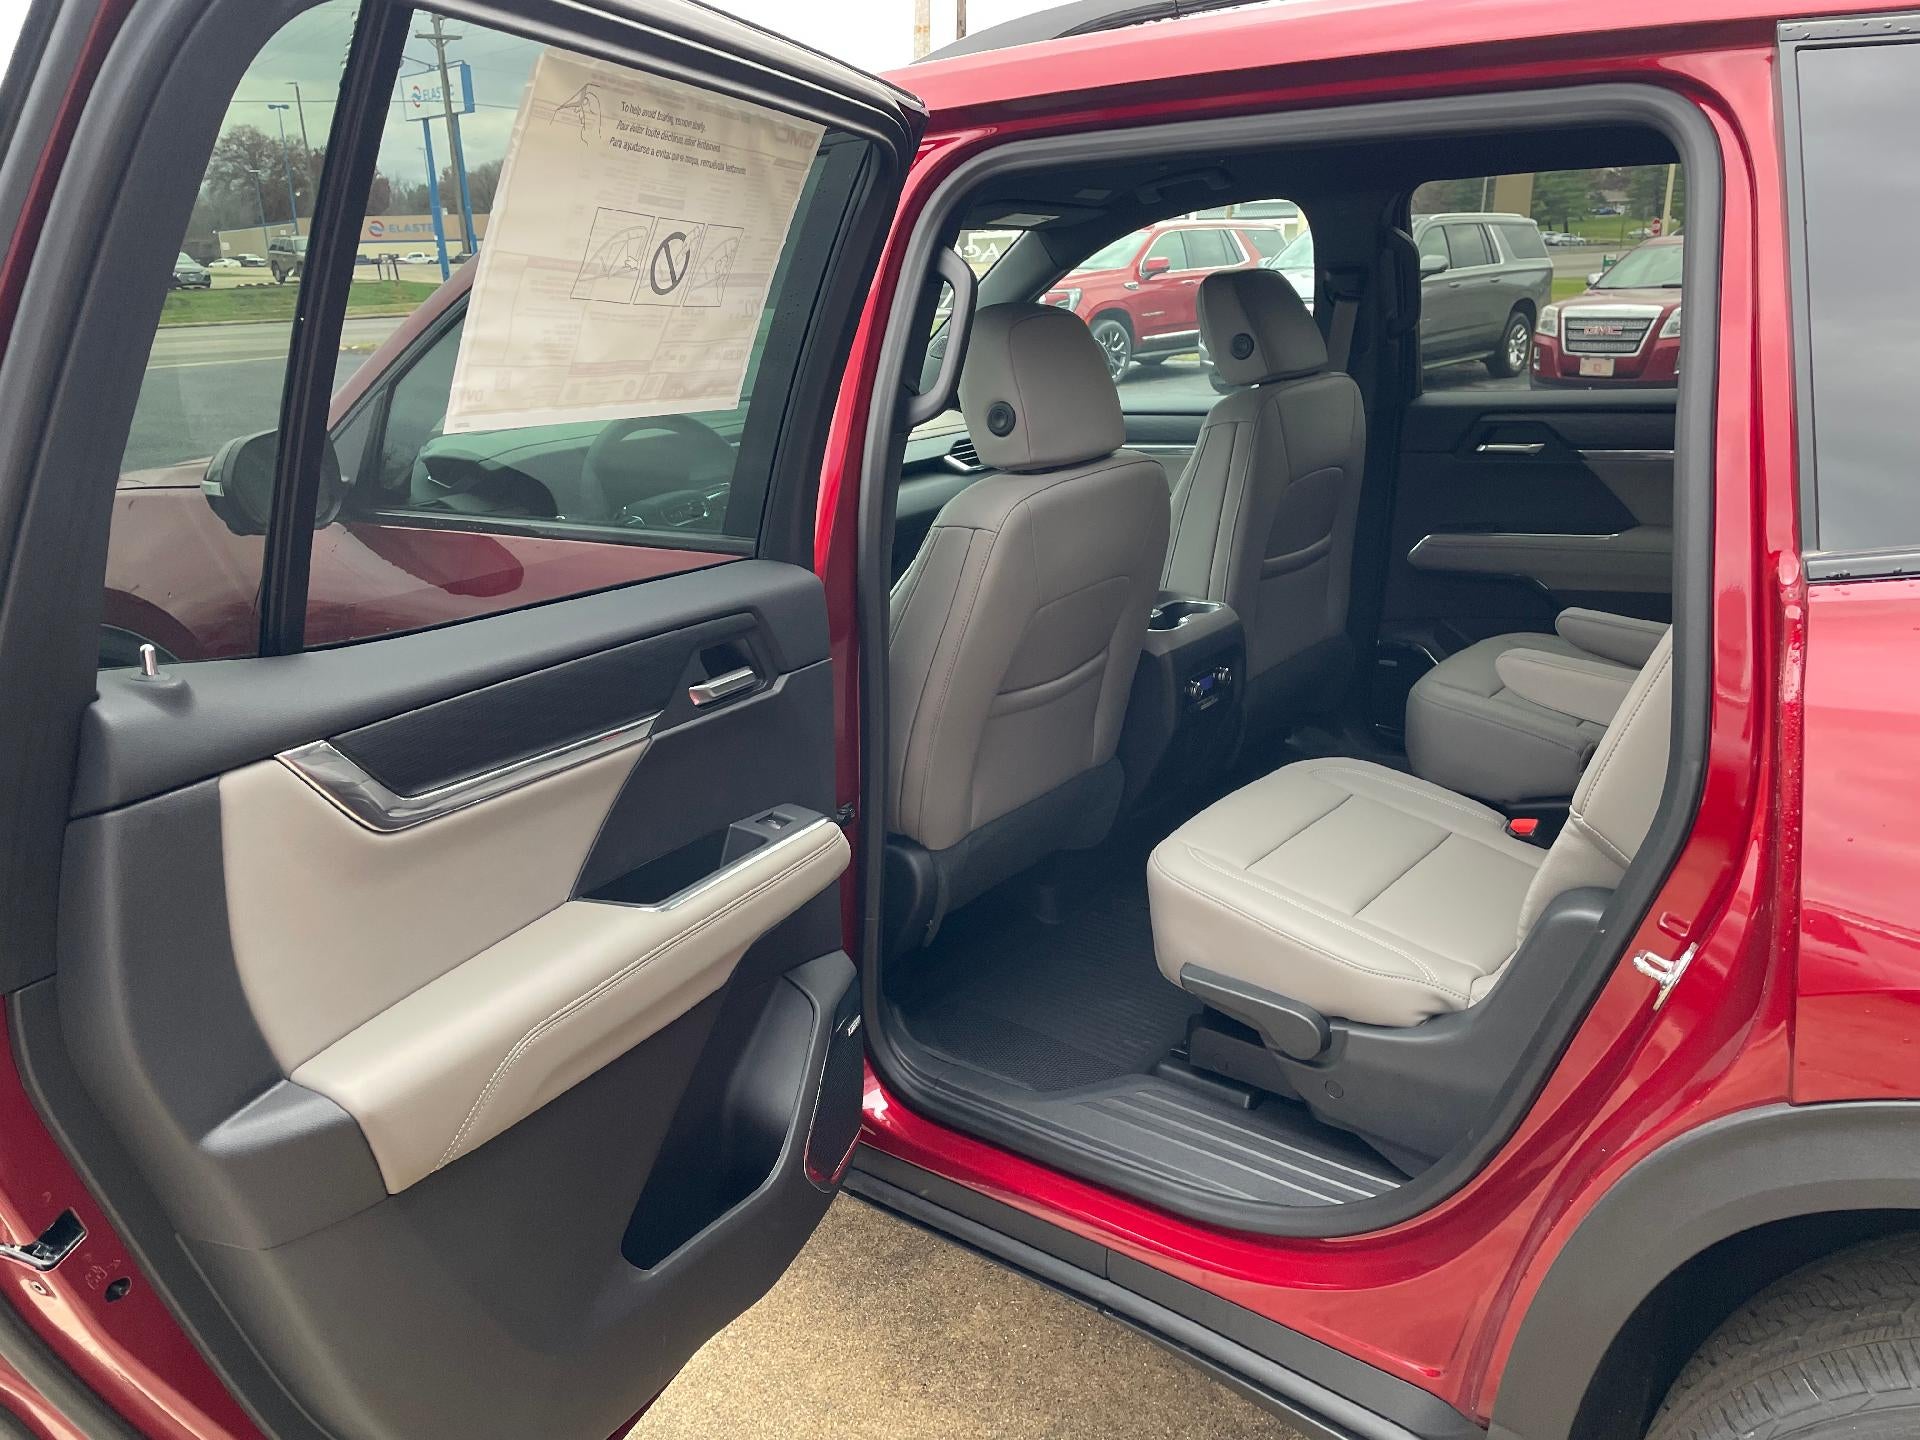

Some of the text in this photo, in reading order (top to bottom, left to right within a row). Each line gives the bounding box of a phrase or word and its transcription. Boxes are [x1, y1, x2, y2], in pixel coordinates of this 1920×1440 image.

[422, 84, 455, 100] ELASC
[621, 101, 629, 113] To
[630, 104, 641, 117] help
[641, 109, 657, 119] avoid
[609, 136, 623, 149] Para
[623, 141, 650, 155] ayudarse
[388, 223, 434, 233] ELASTE
[1583, 325, 1624, 336] GMC
